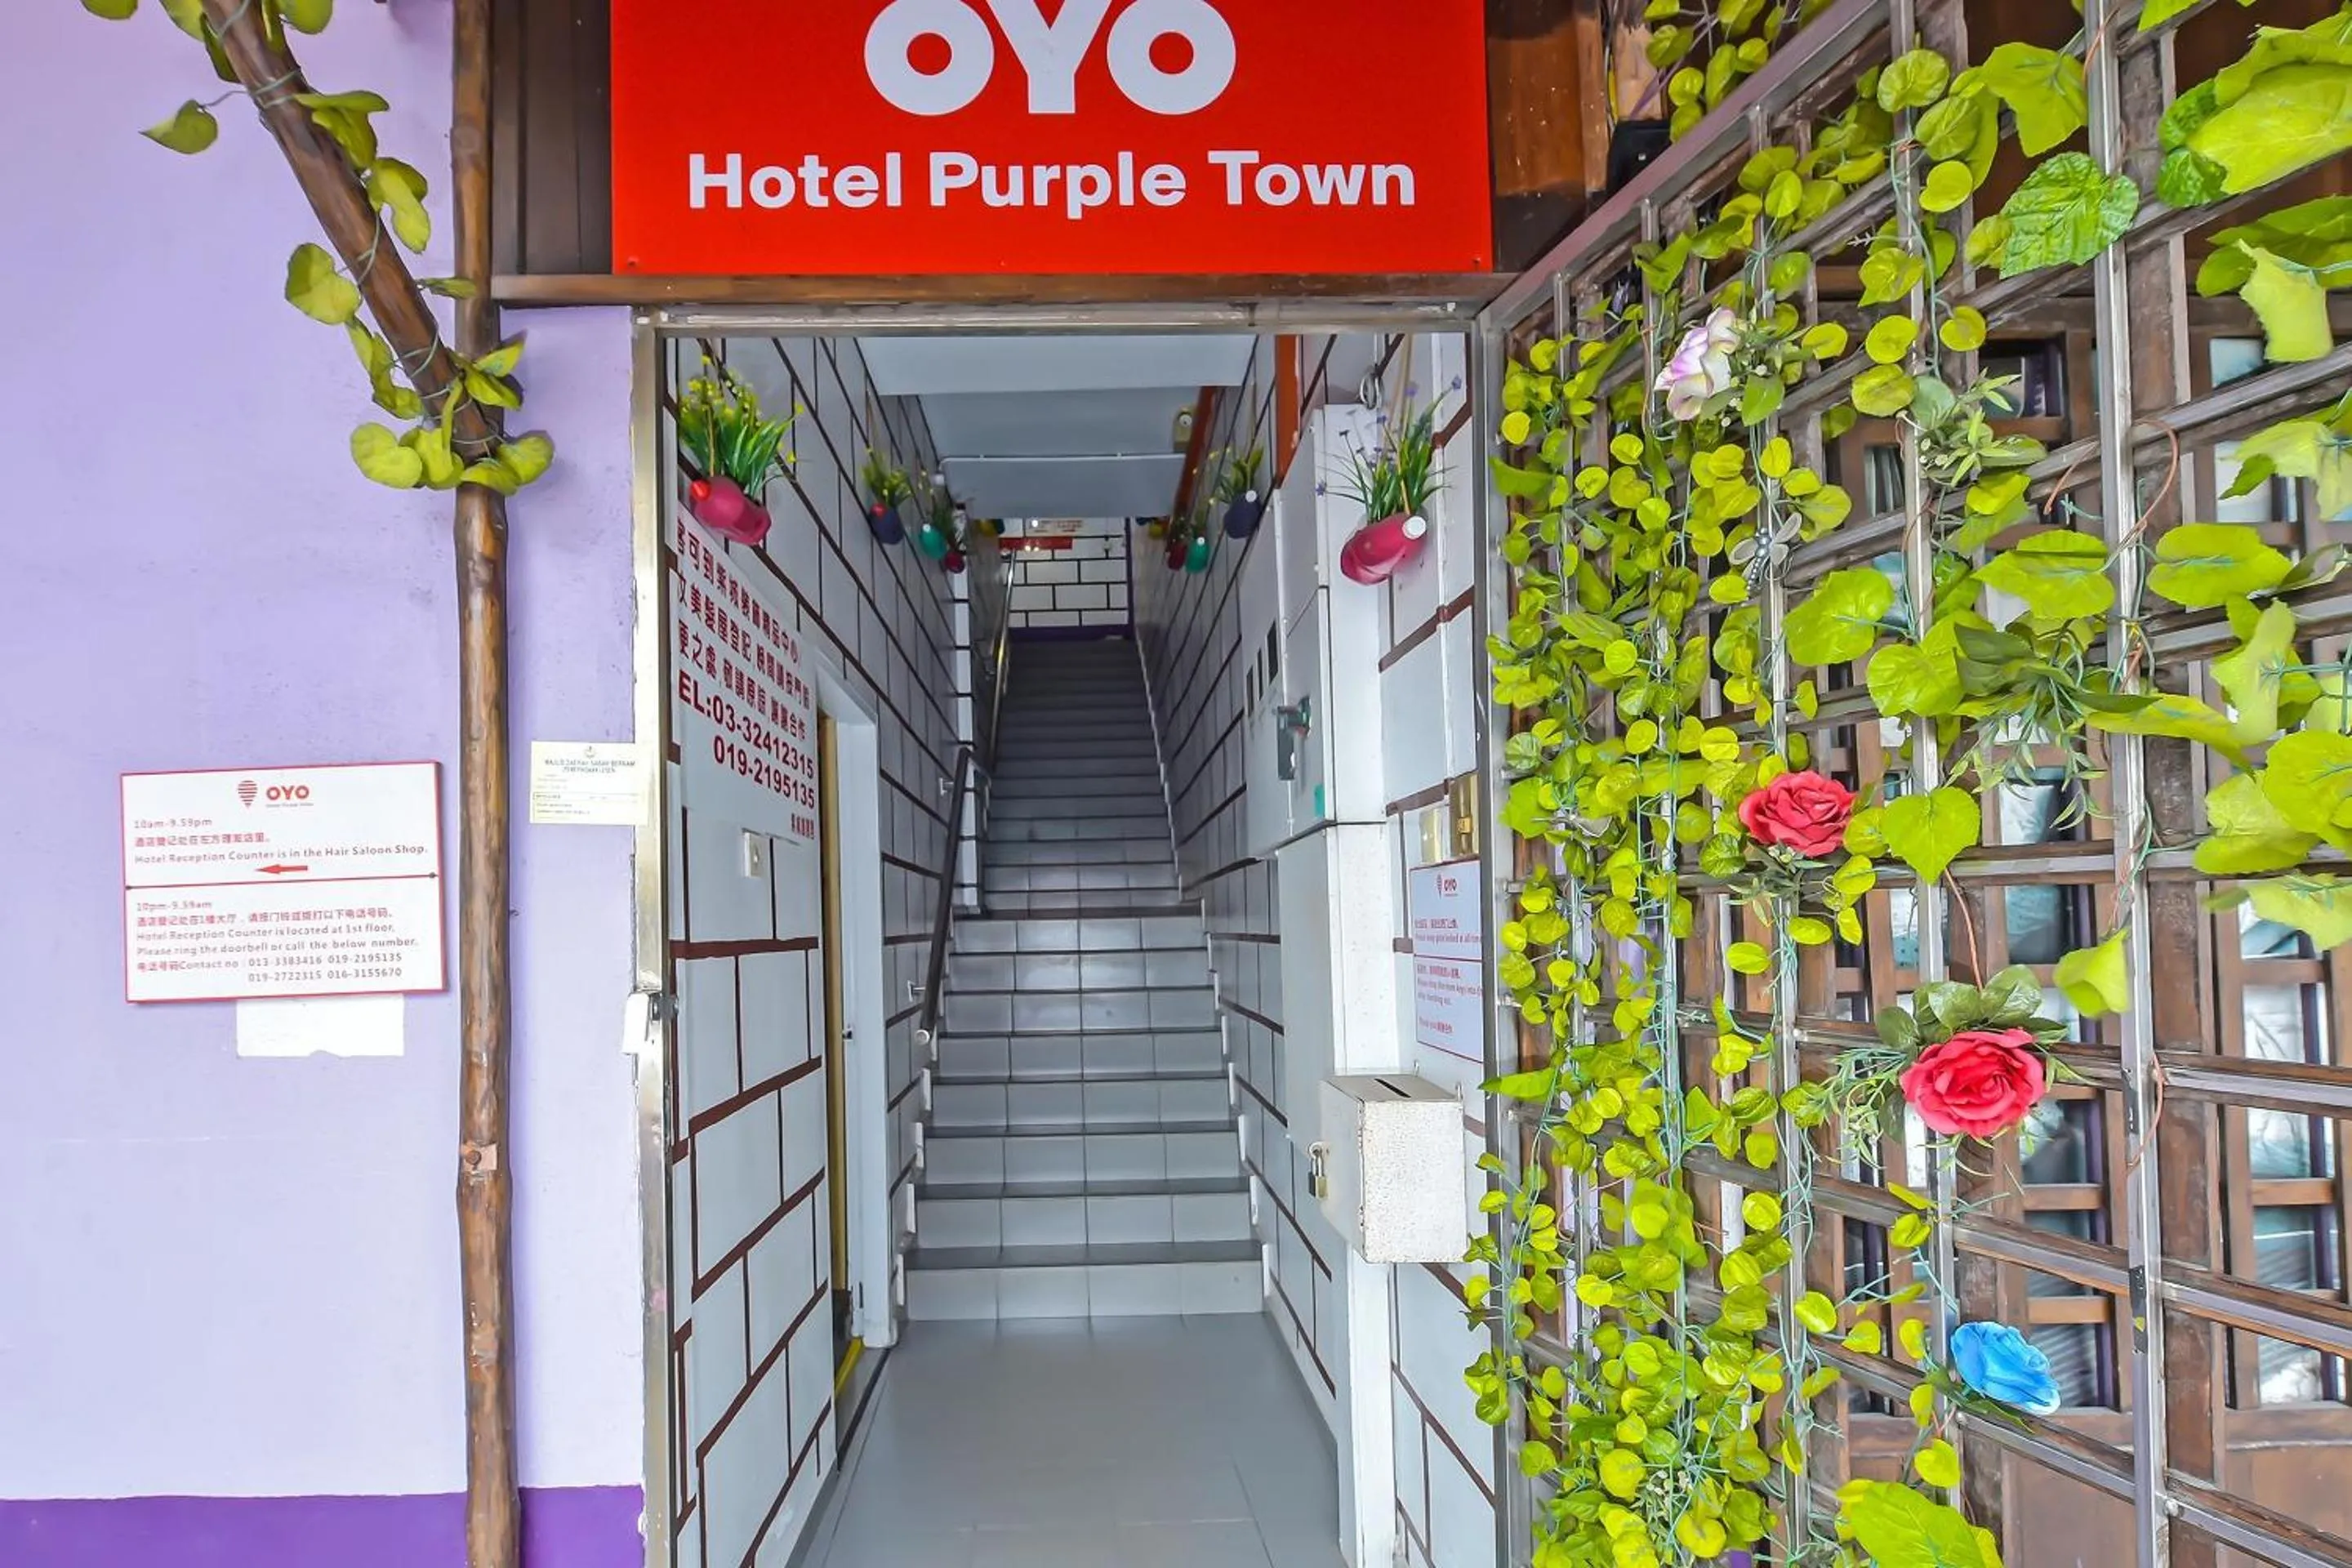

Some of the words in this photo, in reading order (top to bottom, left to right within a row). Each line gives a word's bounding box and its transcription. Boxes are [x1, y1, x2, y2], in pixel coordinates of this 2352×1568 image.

[865, 0, 1236, 115] OYO
[689, 153, 902, 208] Hotel
[930, 151, 1186, 220] Purple
[1209, 150, 1415, 206] Town
[713, 735, 815, 808] 019-2195135
[266, 786, 310, 800] OYO
[169, 853, 225, 863] Reception
[228, 850, 274, 861] Counter
[278, 849, 287, 858] is
[289, 849, 300, 858] in
[304, 848, 322, 857] the
[325, 847, 348, 857] Hair
[352, 846, 392, 856] Saloon
[394, 844, 428, 855] Shop.
[169, 930, 225, 941] Reception
[228, 929, 273, 938] Counter
[287, 924, 328, 936] located
[332, 925, 342, 934] at
[346, 924, 362, 933] 1st
[200, 945, 218, 954] the
[220, 942, 268, 953] doorbell
[286, 941, 305, 951] call
[310, 941, 327, 950] the
[332, 939, 366, 949] below
